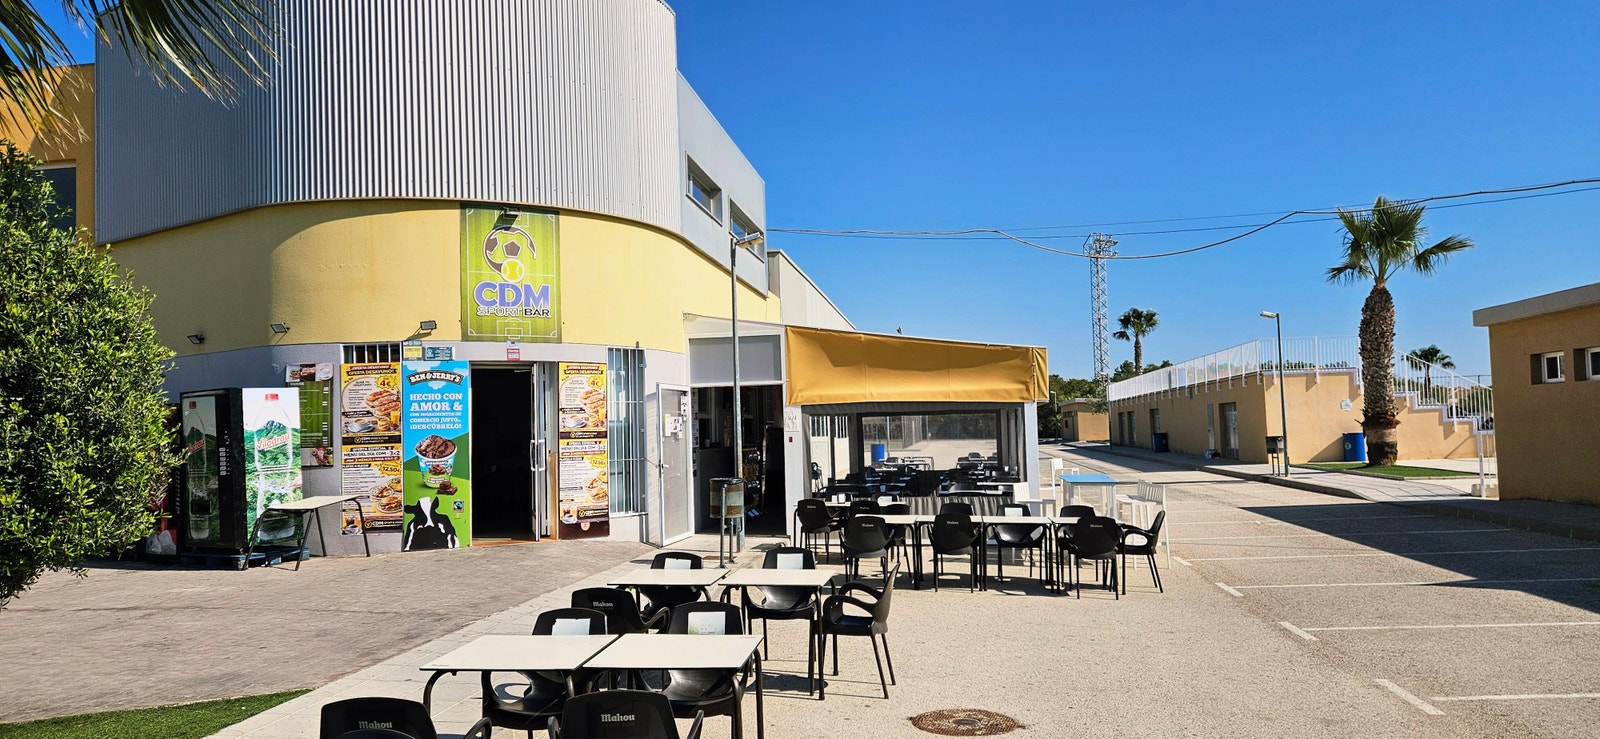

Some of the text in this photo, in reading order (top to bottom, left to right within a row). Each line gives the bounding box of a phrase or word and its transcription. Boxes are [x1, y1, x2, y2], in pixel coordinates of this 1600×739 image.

[474, 281, 550, 310] CDM
[476, 306, 550, 317] SPORT BAR
[410, 373, 426, 382] BEN
[432, 372, 461, 382] JERRY'S
[410, 402, 462, 412] AMOR &
[256, 432, 290, 451] Viladrau
[601, 713, 635, 722] Mahou
[358, 720, 392, 729] Mahou
